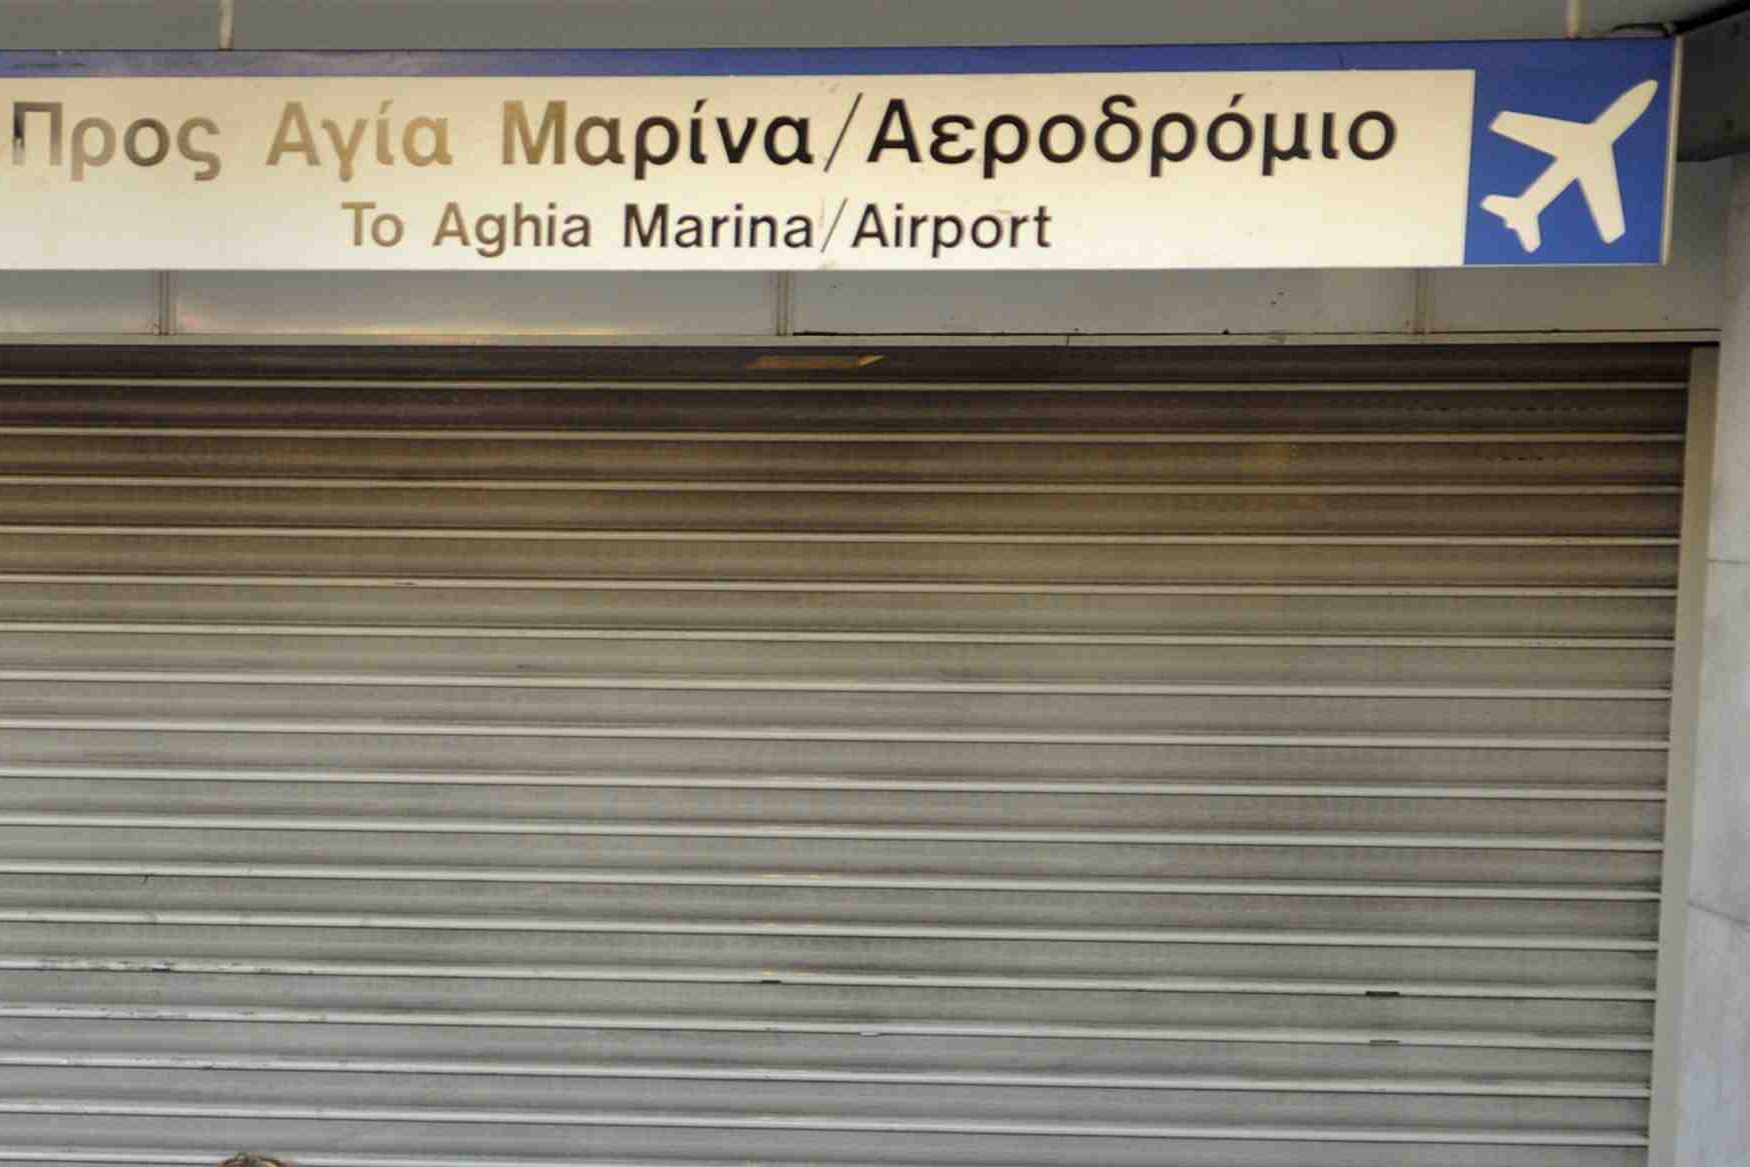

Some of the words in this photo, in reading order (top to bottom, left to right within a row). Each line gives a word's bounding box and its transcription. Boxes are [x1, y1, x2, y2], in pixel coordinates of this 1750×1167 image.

[11, 101, 223, 184] Προς
[264, 99, 454, 184] Αγία
[339, 201, 406, 249] To
[431, 200, 593, 259] Aghia
